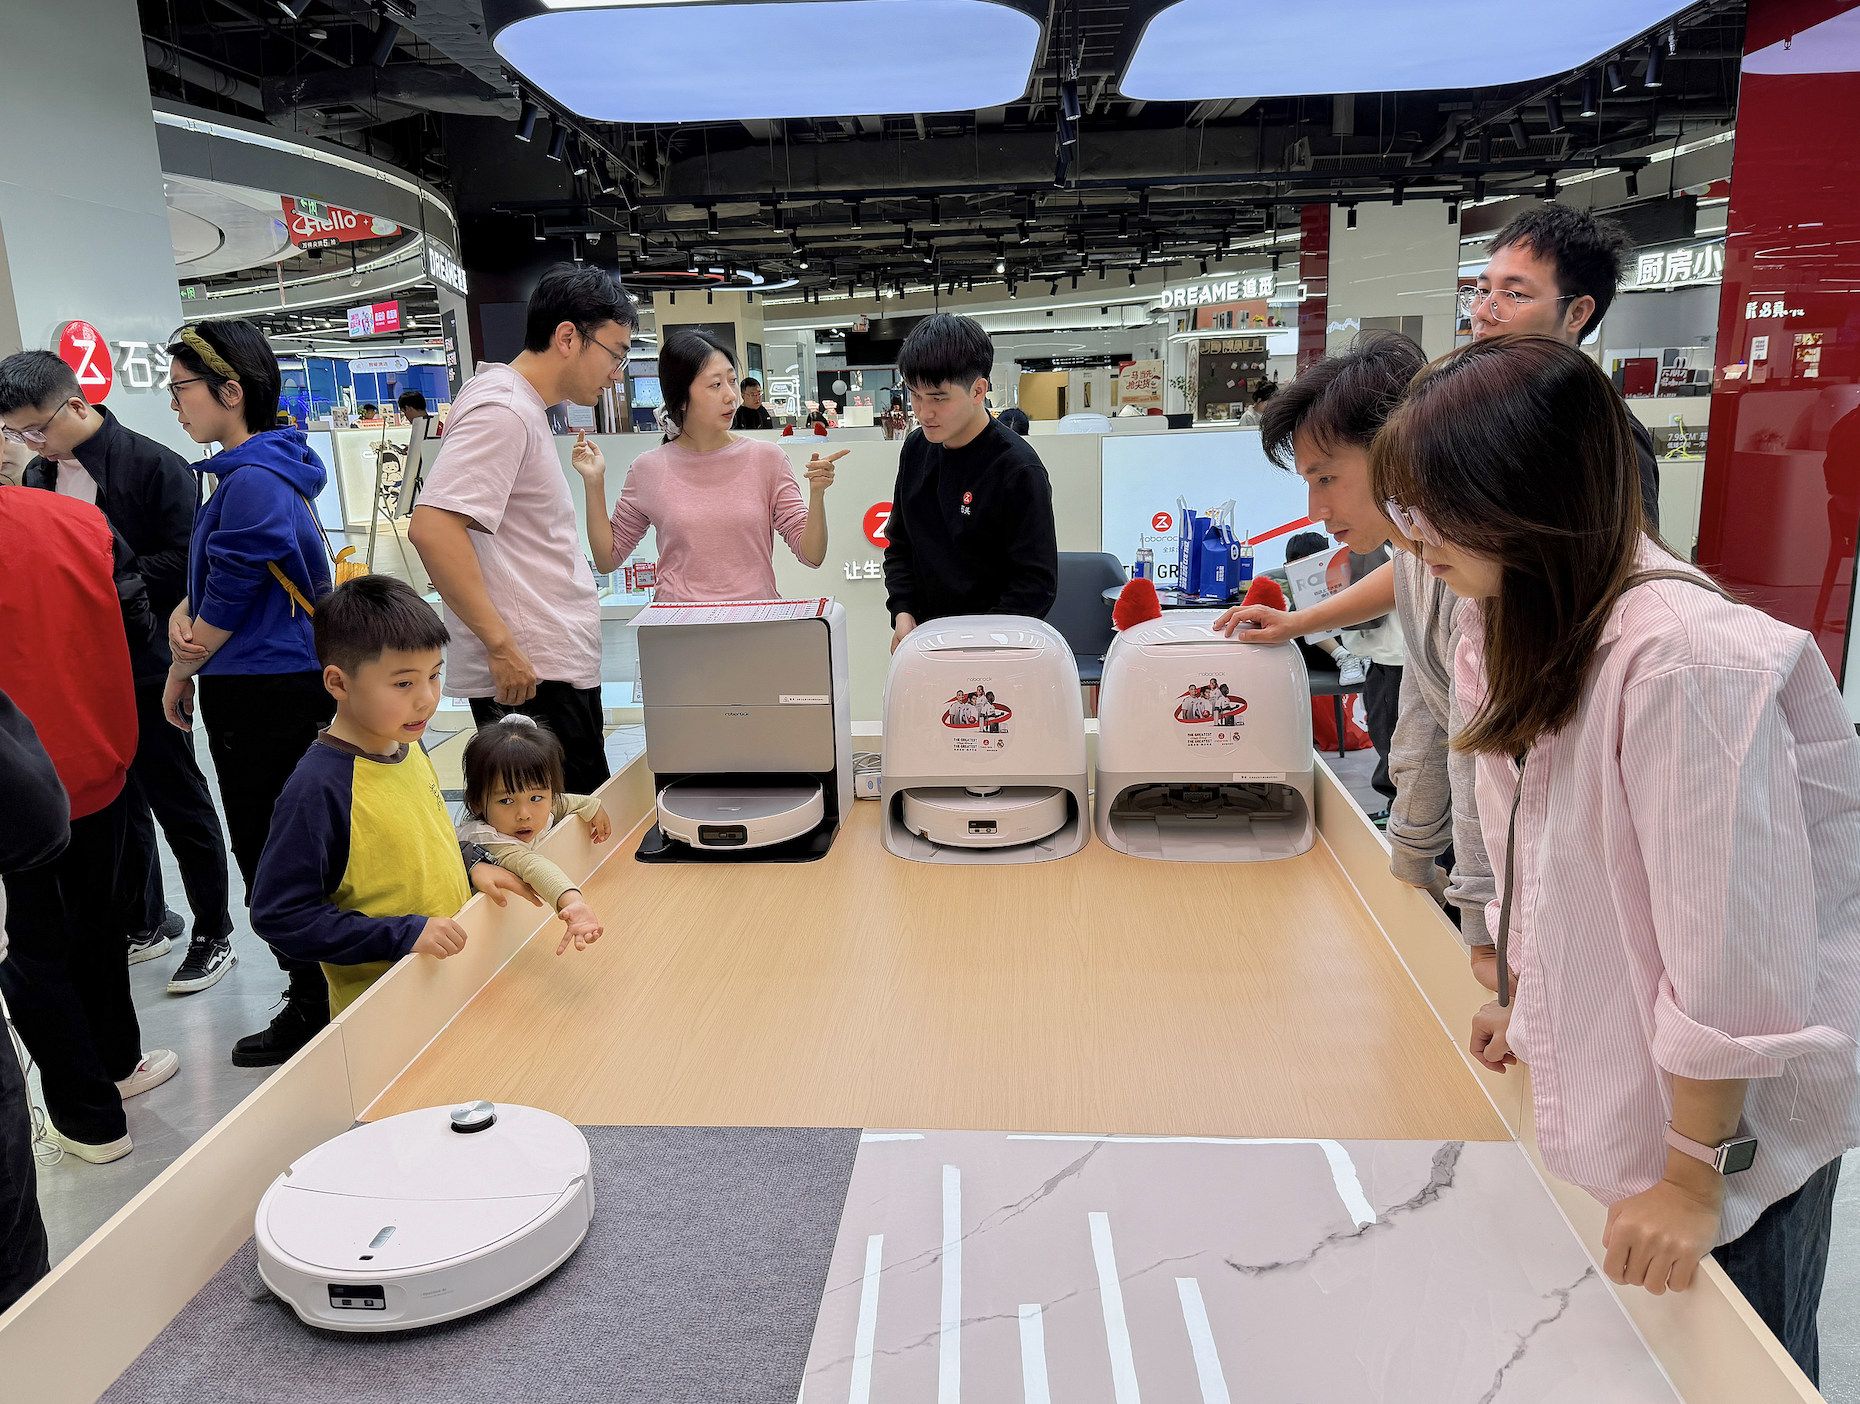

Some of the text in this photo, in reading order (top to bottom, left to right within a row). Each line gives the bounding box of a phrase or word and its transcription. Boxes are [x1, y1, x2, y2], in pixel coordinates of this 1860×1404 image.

[1161, 281, 1239, 308] DREAME
[1200, 339, 1264, 354] JD MALL
[844, 560, 886, 580] 让生
